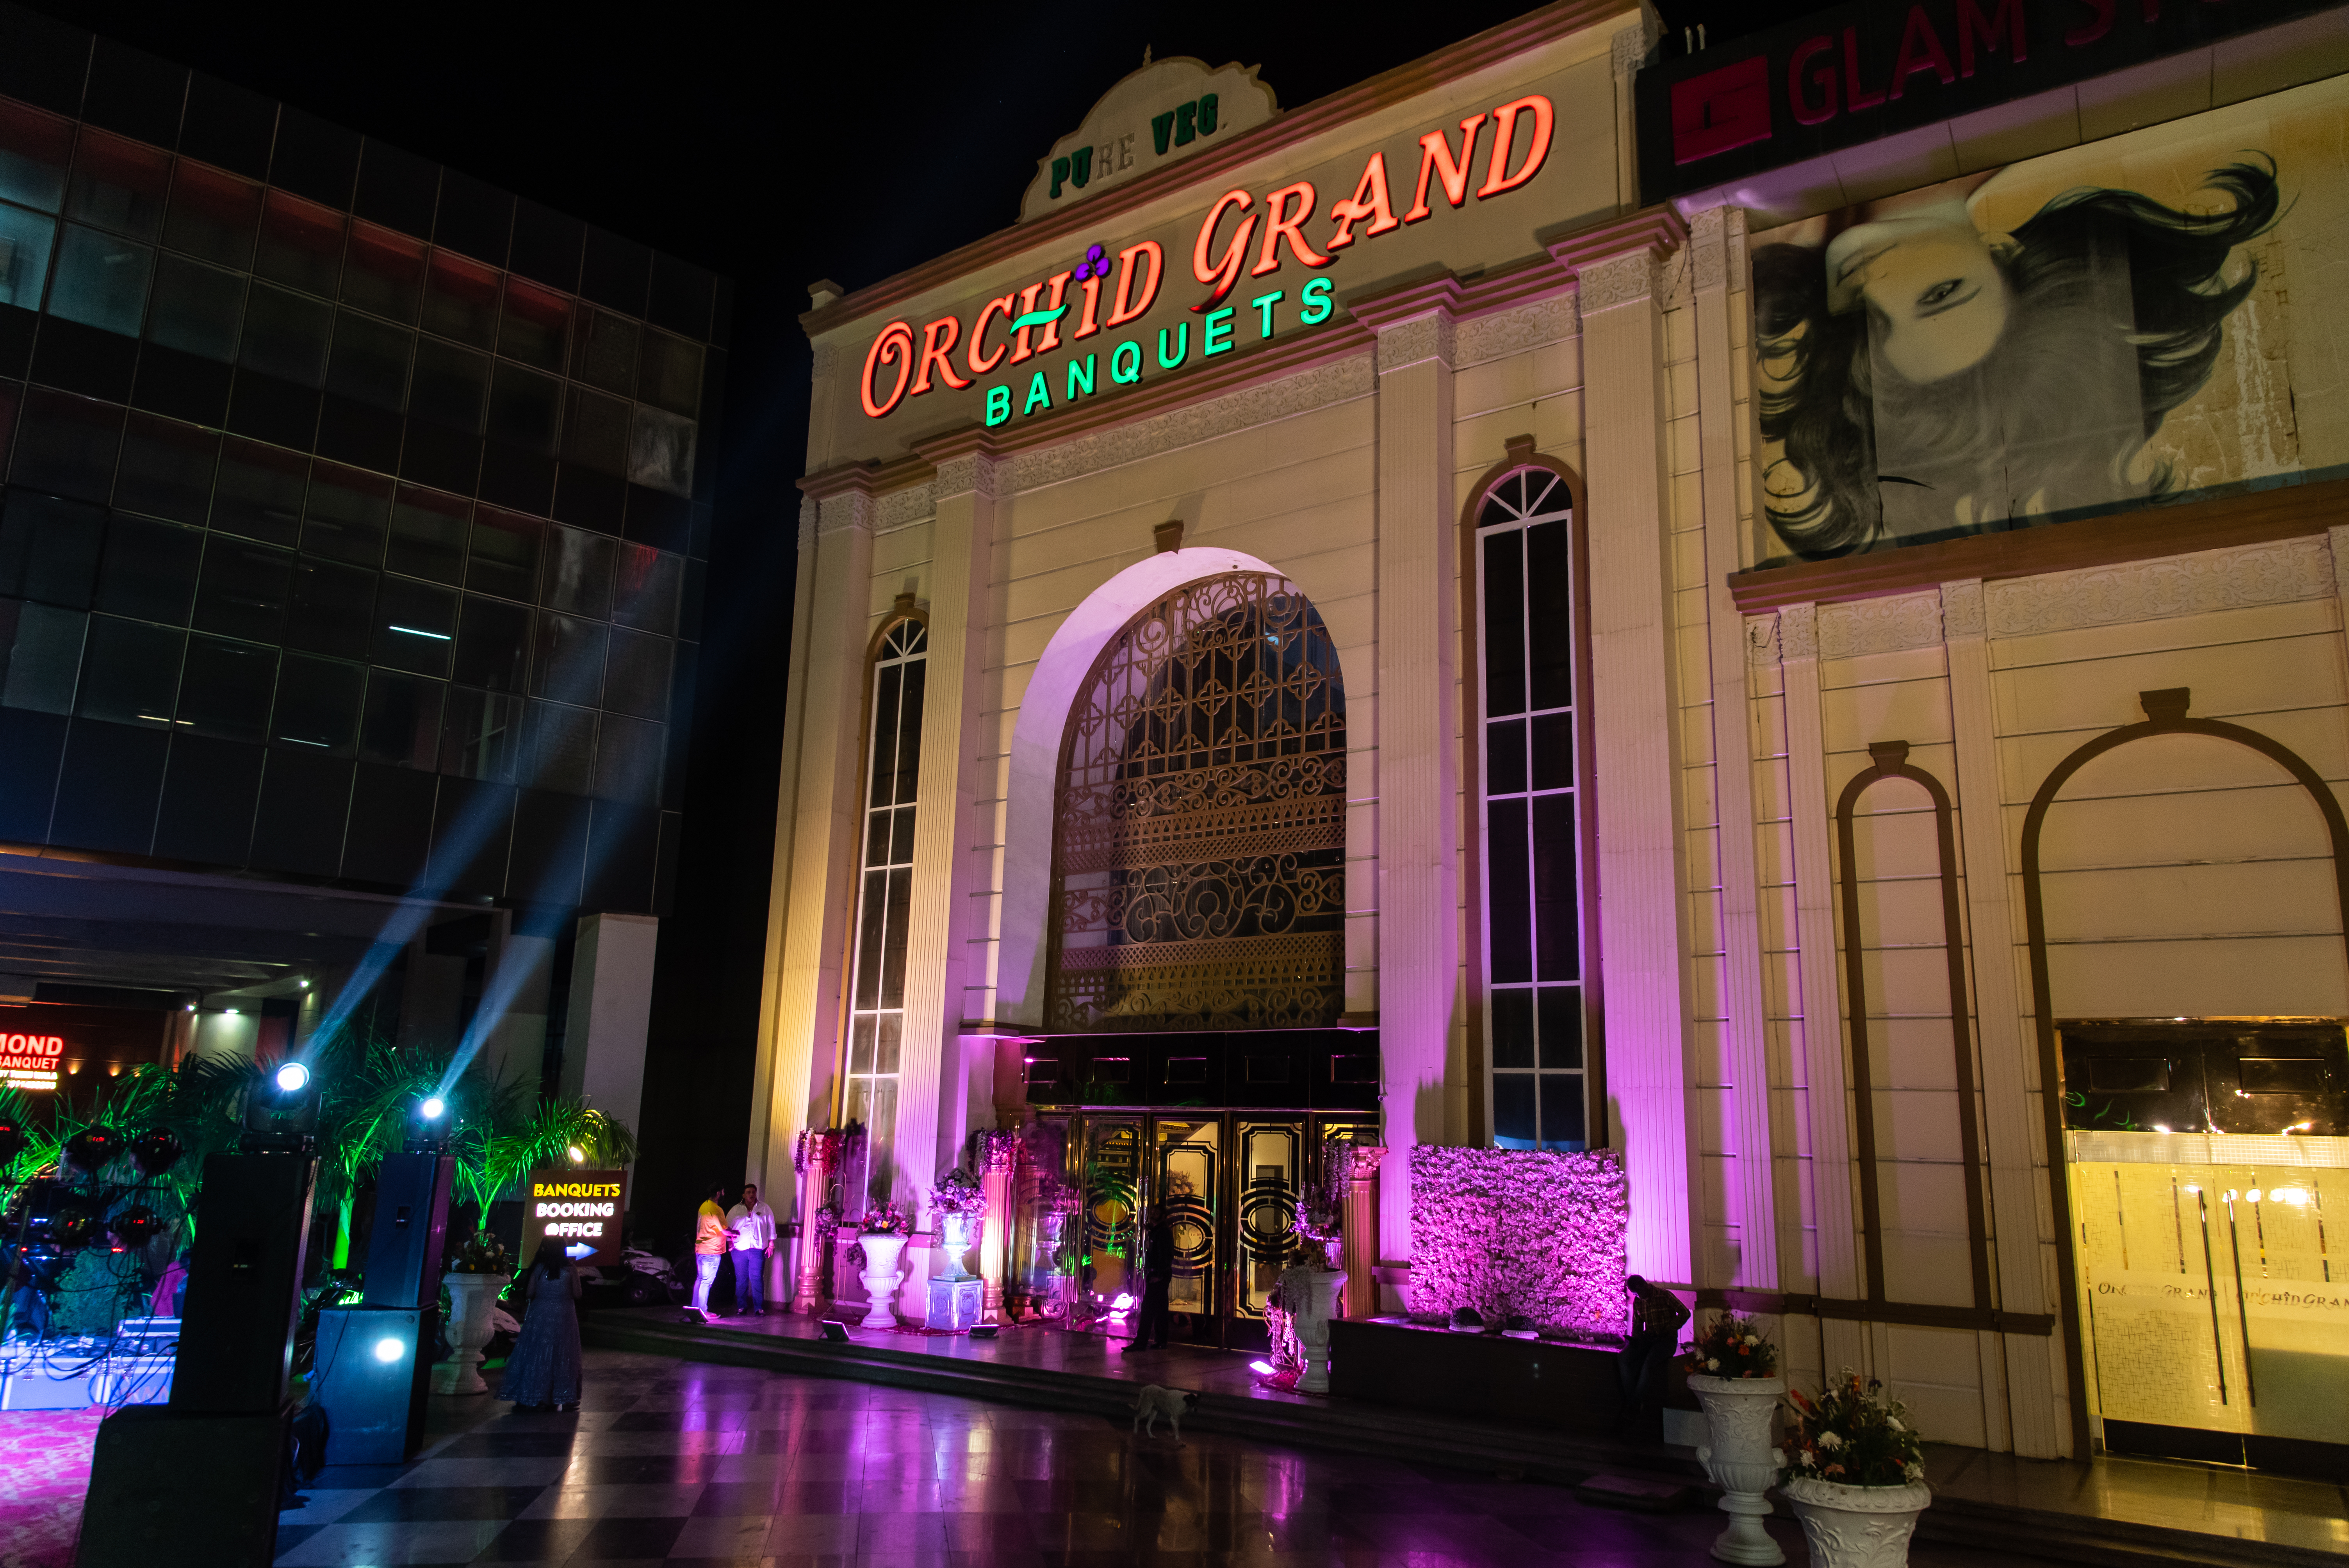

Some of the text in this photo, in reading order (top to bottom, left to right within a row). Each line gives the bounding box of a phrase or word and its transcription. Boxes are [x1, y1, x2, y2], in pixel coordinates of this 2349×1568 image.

[1788, 0, 2026, 125] GLAM
[1050, 132, 1134, 199] PURE
[1192, 94, 1554, 312] GRAND
[986, 277, 1332, 427] BANQUETS
[533, 1183, 620, 1197] BANQUETS
[536, 1203, 614, 1217] BOOKING
[545, 1222, 603, 1237] OFFICE
